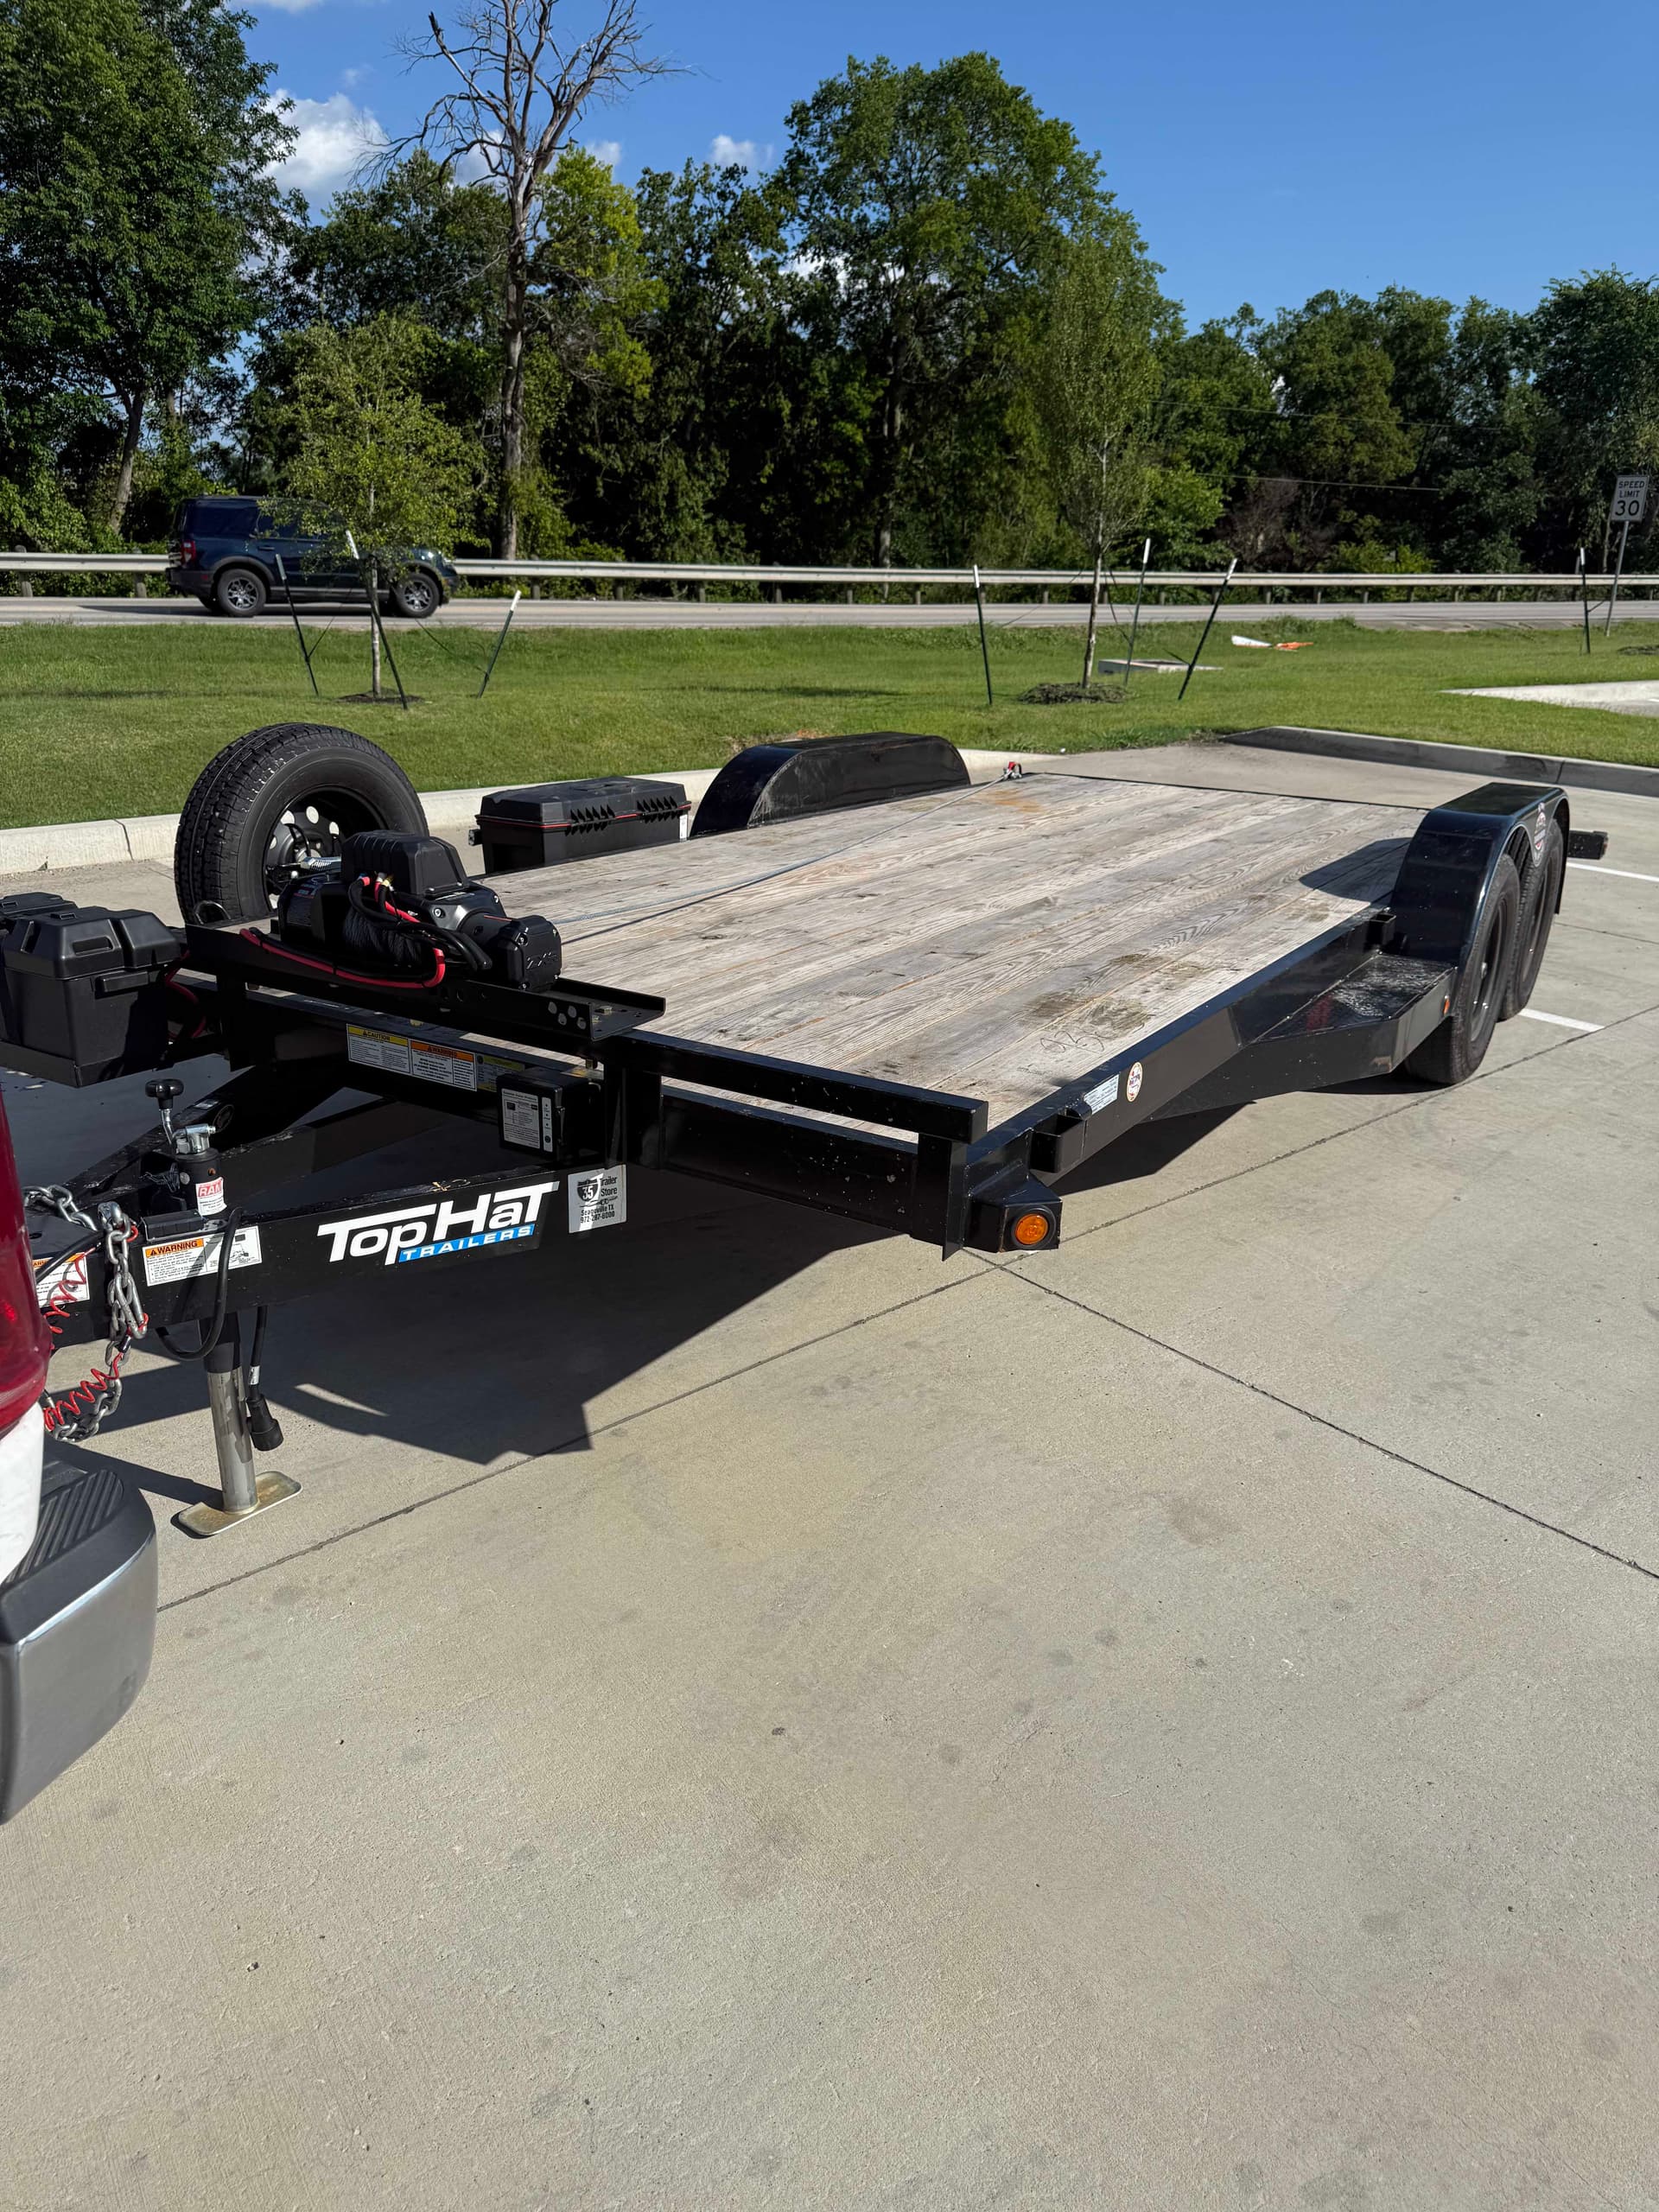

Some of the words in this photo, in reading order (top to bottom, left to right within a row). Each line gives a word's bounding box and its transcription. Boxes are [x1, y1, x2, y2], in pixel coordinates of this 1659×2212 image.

[1615, 499, 1640, 516] 30
[600, 1176, 618, 1185] Trailer
[582, 1185, 594, 1199] 35
[601, 1187, 618, 1197] Store
[156, 1240, 198, 1254] WARNING
[402, 1226, 532, 1261] TRAILERS
